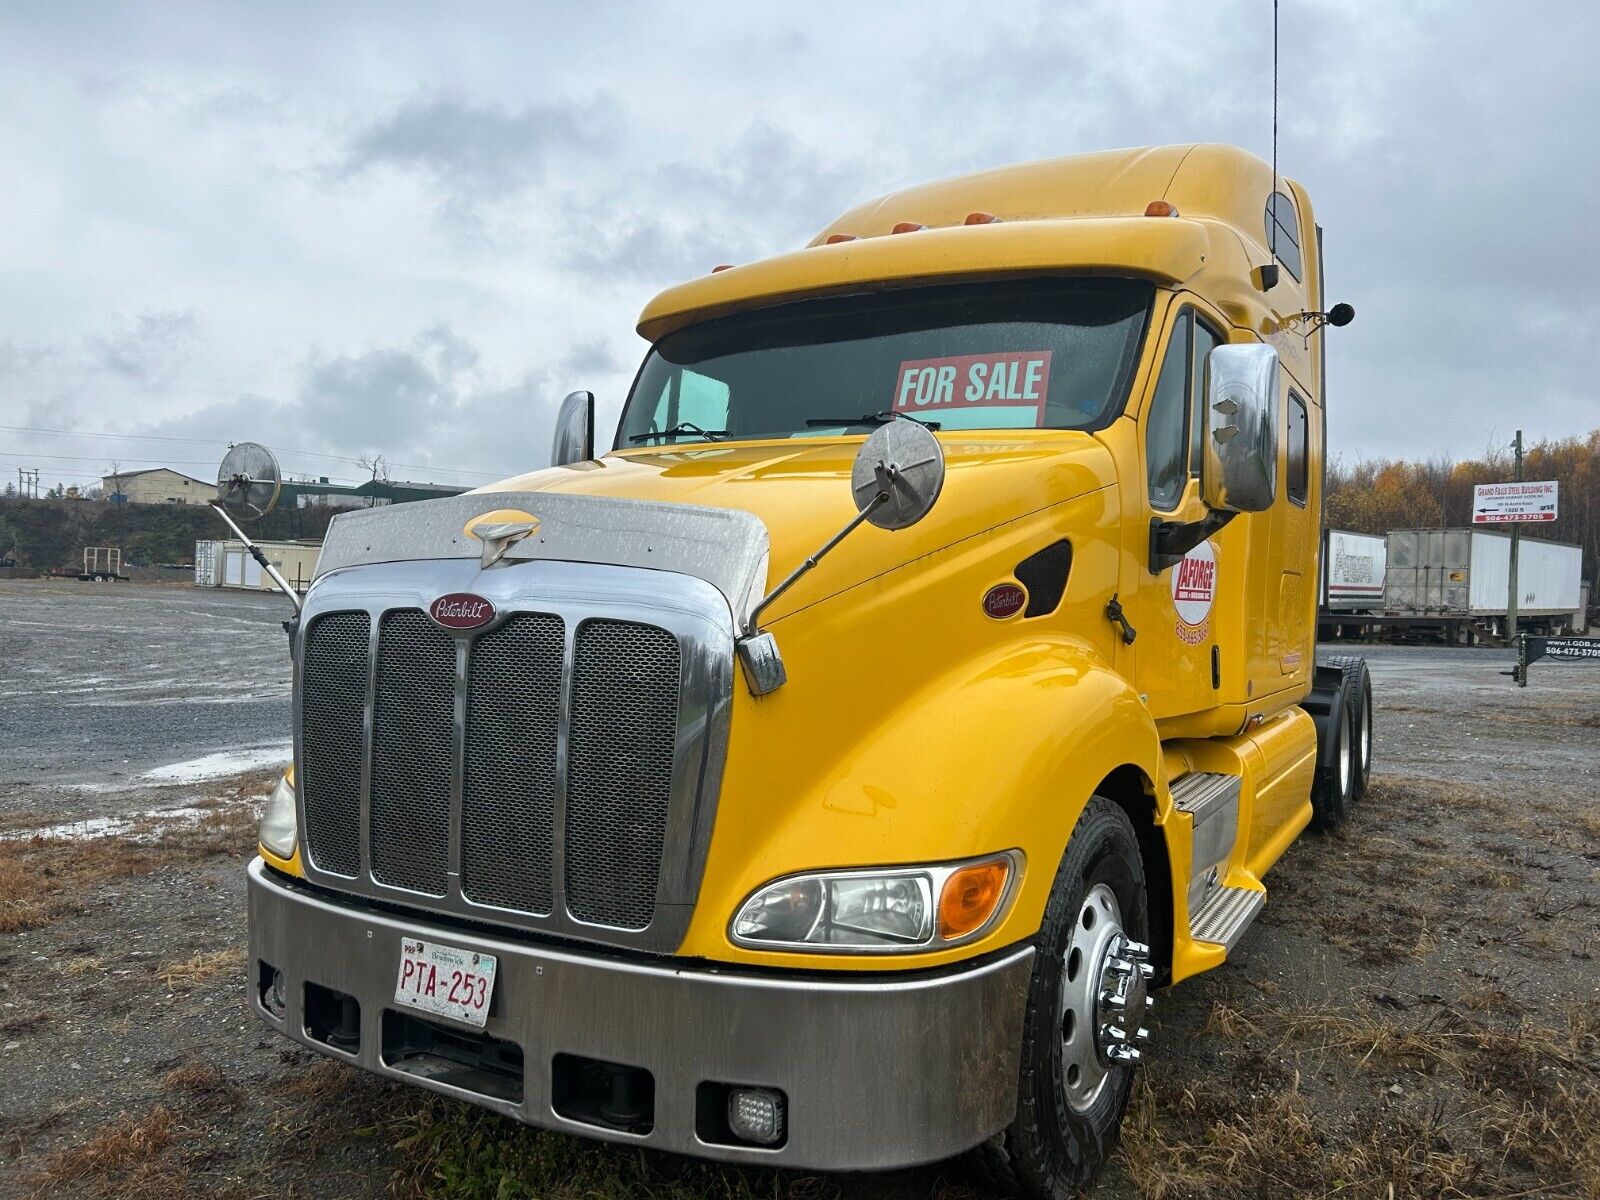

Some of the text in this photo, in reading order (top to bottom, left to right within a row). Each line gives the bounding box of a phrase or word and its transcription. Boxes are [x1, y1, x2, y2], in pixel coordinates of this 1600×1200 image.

[899, 360, 1044, 407] FOR SALE
[1478, 487, 1494, 496] GRAND
[1485, 513, 1544, 521] 506-473-3705
[436, 598, 488, 618] Peterbilt
[401, 959, 487, 1009] PTA-253
